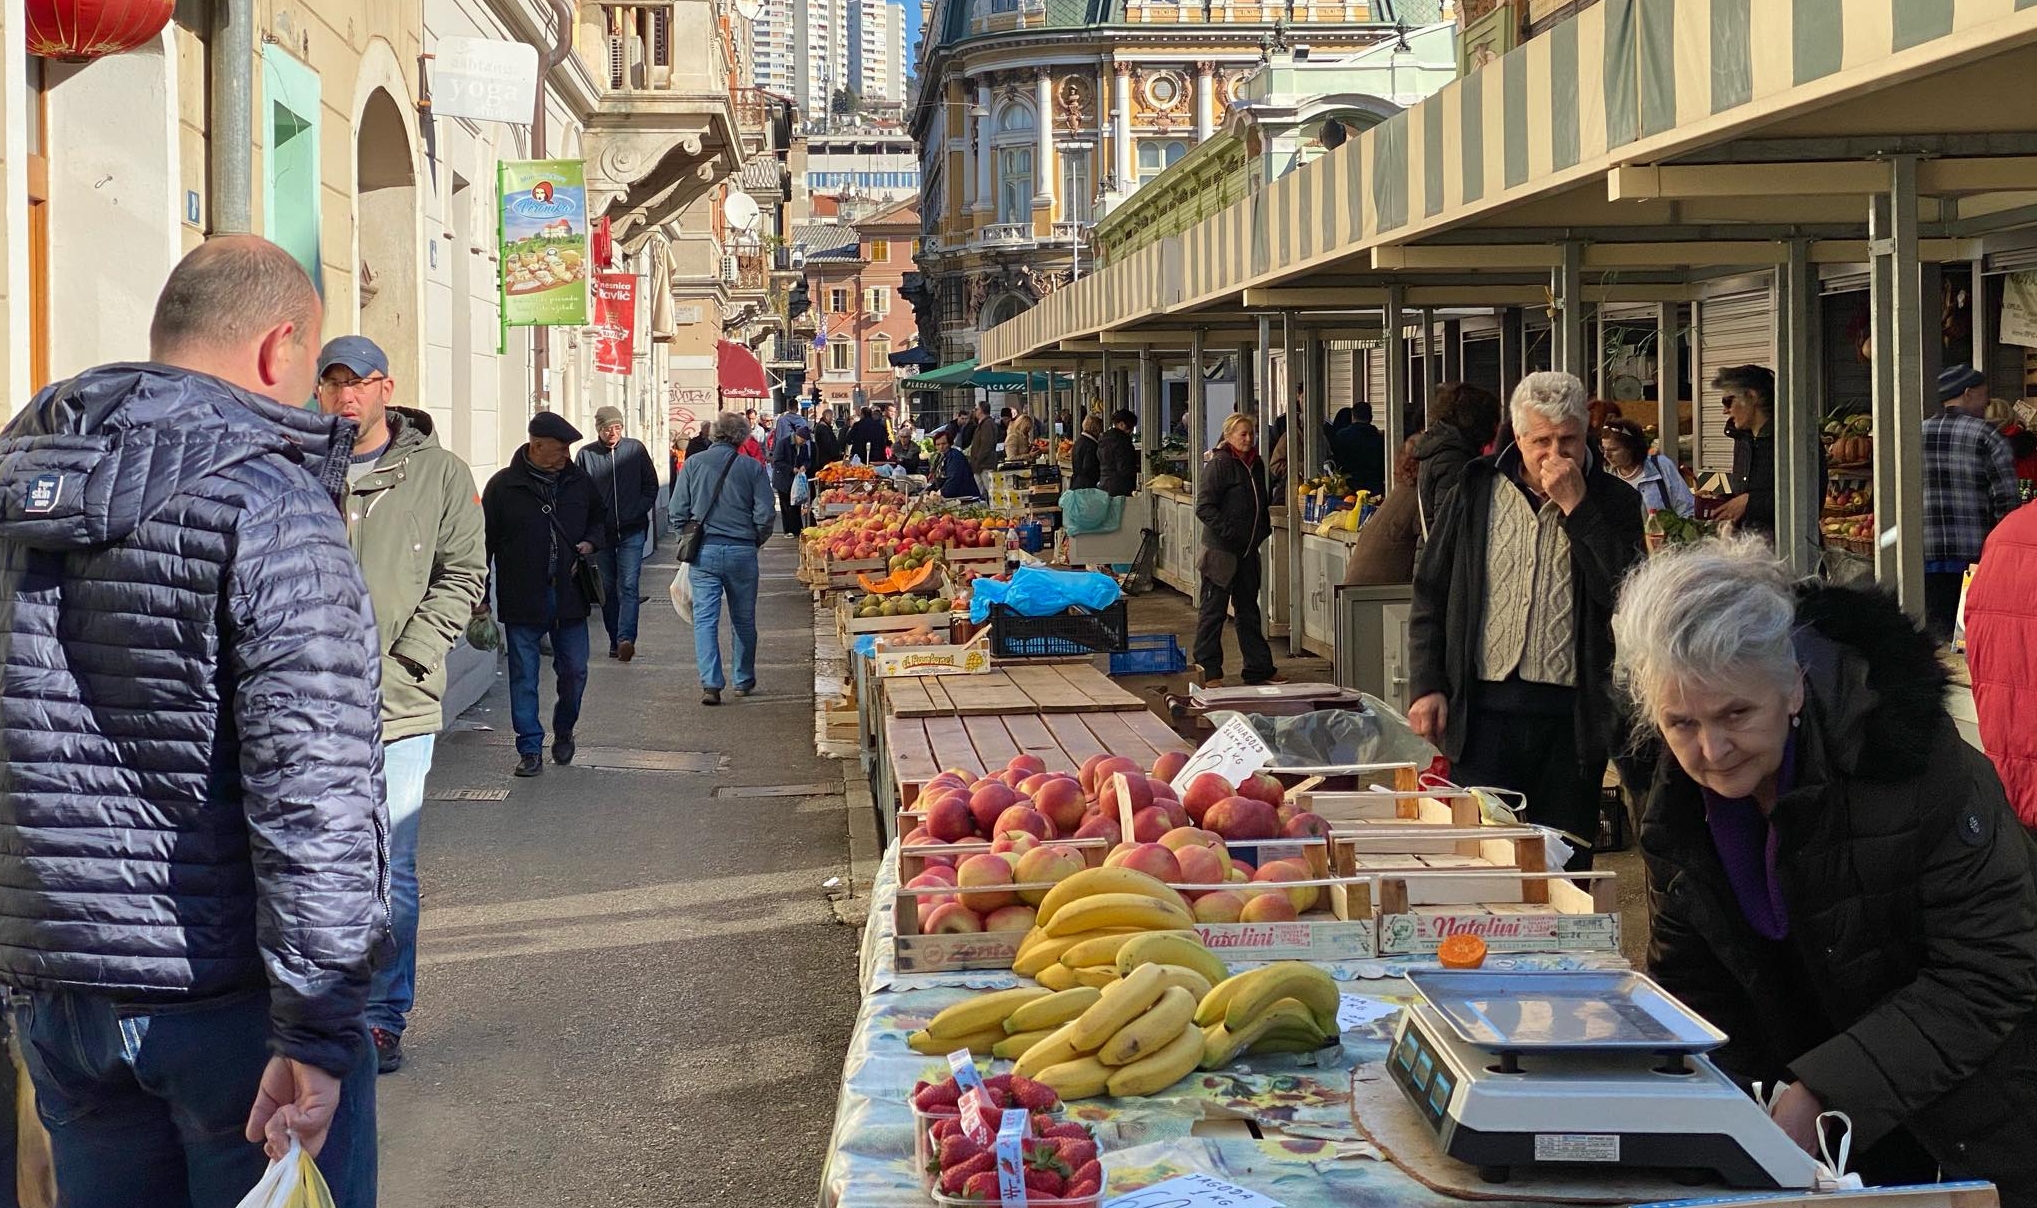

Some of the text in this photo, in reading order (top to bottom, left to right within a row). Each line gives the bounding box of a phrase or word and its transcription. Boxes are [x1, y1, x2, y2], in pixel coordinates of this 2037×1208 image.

[448, 79, 518, 107] yoga
[516, 199, 570, 214] Veronika
[746, 388, 762, 397] Shop
[1232, 752, 1244, 765] KG
[1432, 916, 1521, 938] Natalini
[1185, 1174, 1254, 1200] JAGODA
[1209, 1195, 1234, 1206] KG
